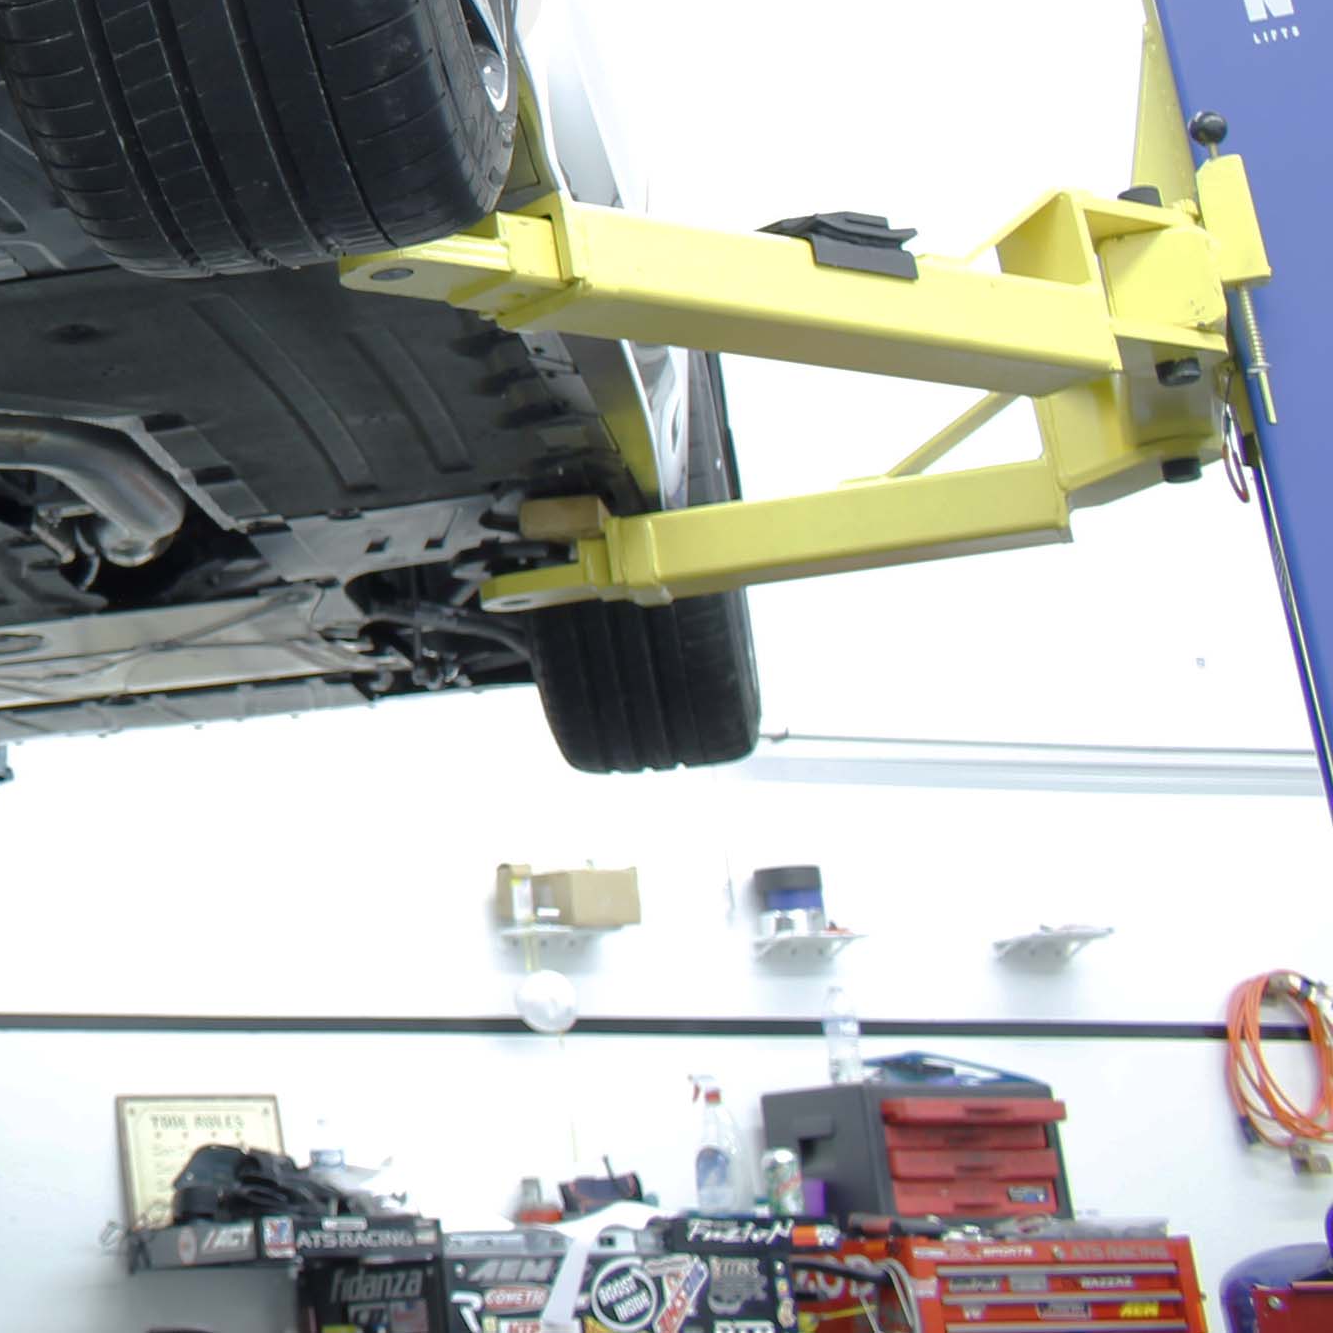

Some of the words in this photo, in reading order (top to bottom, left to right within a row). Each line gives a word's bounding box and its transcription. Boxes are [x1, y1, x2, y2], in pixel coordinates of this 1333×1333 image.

[1252, 25, 1300, 45] LIFTS
[296, 1231, 338, 1249] ATS
[338, 1229, 415, 1248] RACING
